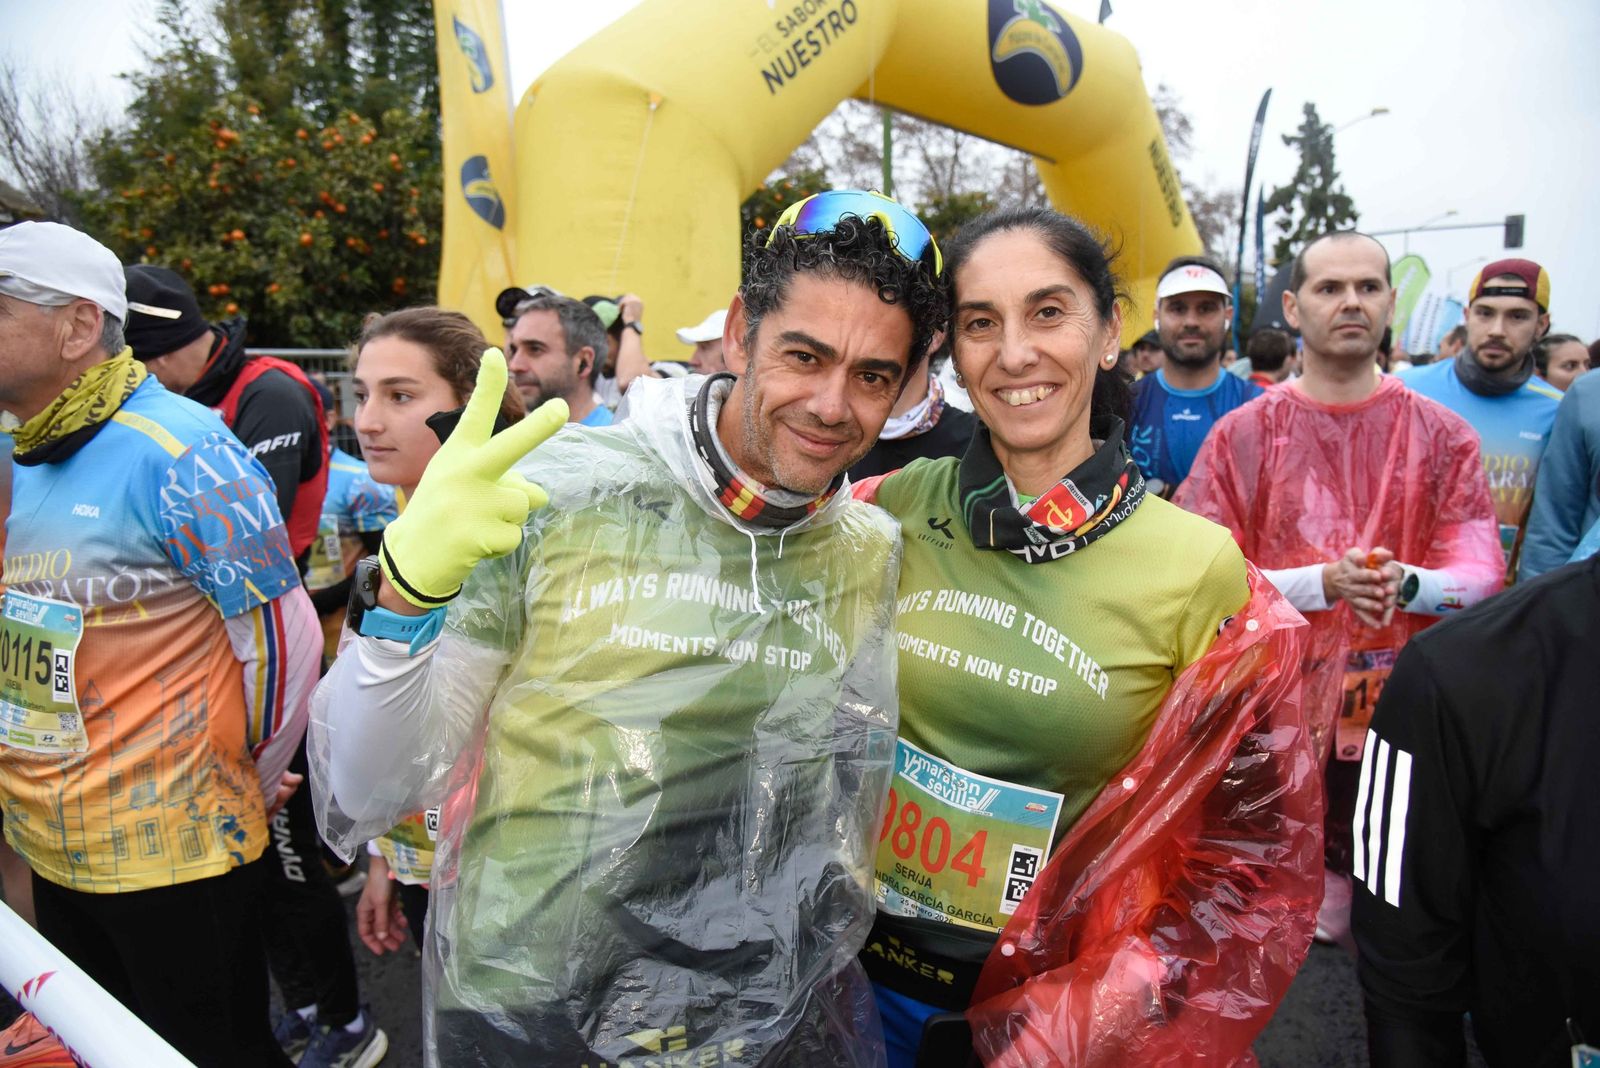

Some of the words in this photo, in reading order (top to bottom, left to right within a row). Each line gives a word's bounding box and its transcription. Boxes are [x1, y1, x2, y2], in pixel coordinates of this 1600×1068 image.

[761, 0, 858, 95] NUESTRO
[71, 503, 100, 520] HOKA
[0, 626, 53, 686] 0115
[606, 622, 717, 657] MOMENTS
[718, 638, 759, 663] NON
[764, 646, 812, 672] STOP
[932, 588, 1018, 630] RUNNING
[1020, 611, 1110, 701] TOGETHER
[964, 653, 1004, 682] NON
[1006, 667, 1058, 697] STOP
[917, 756, 981, 797] maratón
[926, 777, 980, 810] sevilla
[894, 862, 933, 890] SER/JA
[901, 885, 945, 913] GARCÍA
[946, 904, 994, 927] GARCÍA
[862, 941, 955, 986] ANKER
